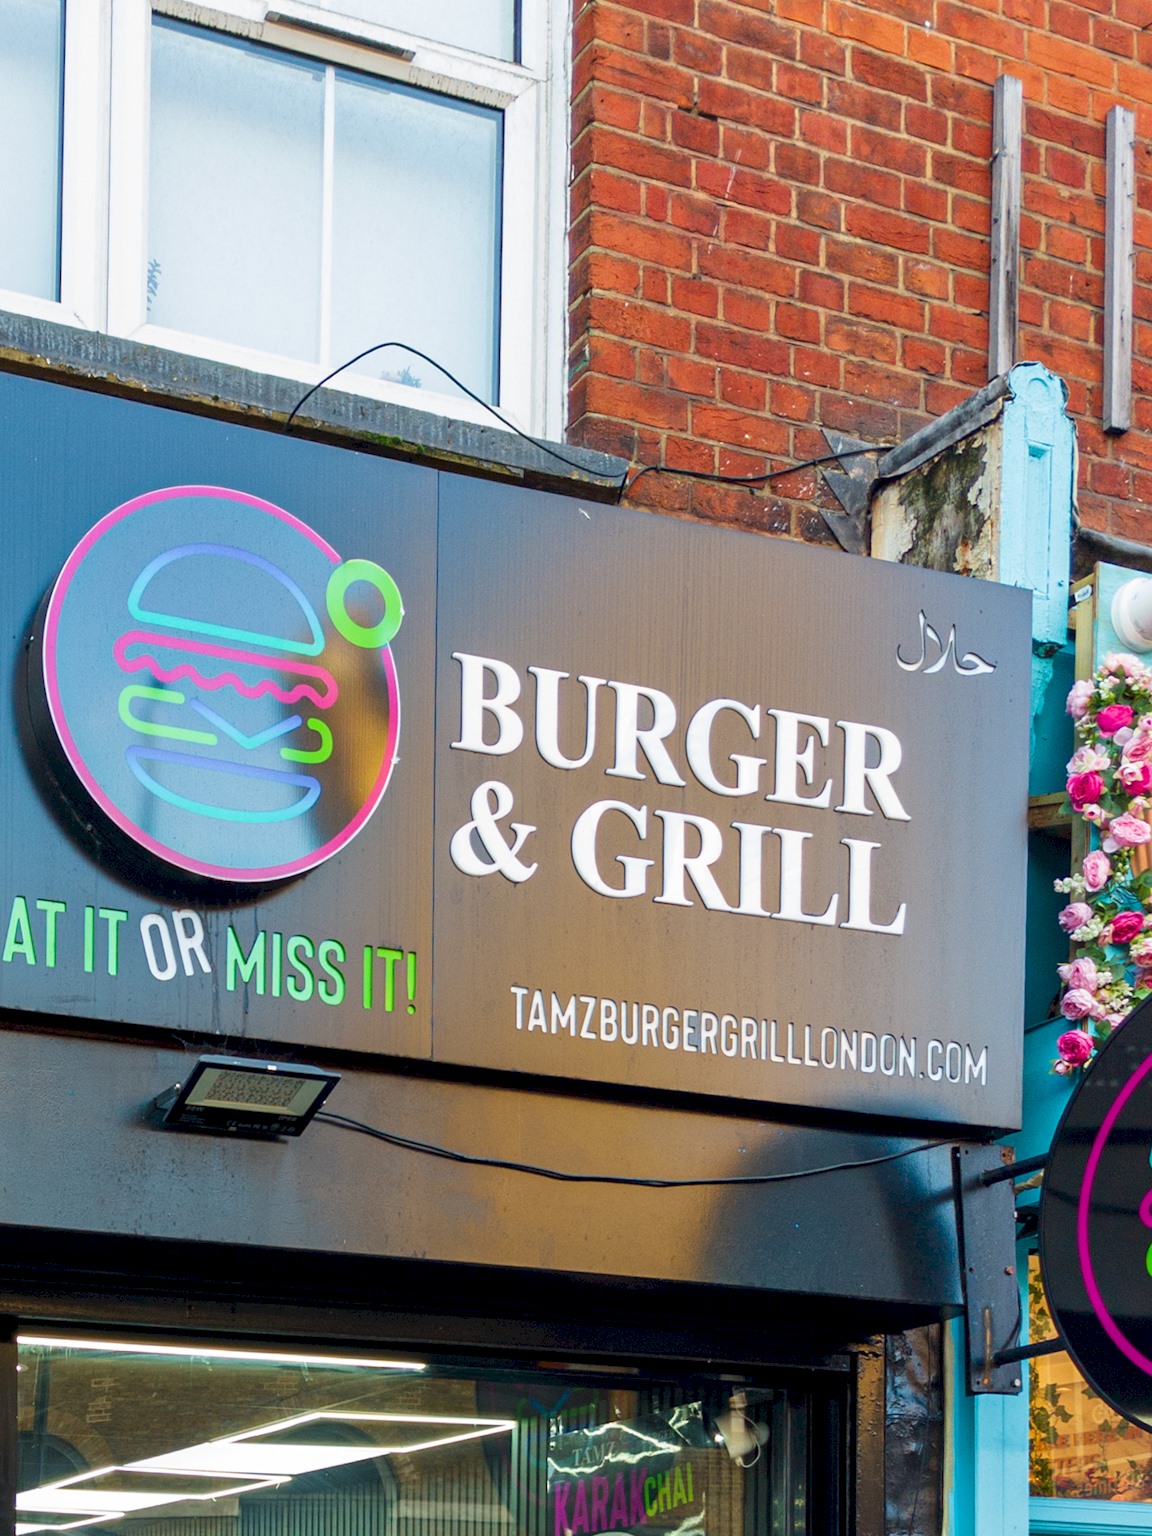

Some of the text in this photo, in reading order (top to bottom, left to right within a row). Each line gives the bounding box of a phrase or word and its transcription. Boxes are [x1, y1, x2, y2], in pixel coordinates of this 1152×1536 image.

[895, 609, 997, 679] حلال
[450, 650, 911, 822] BURGER
[449, 780, 907, 937] & GRILL
[82, 905, 129, 978] IT
[138, 905, 212, 983] OR
[225, 924, 346, 1009] MISS
[361, 946, 418, 1016] IT!
[509, 983, 989, 1089] TAMZBURGERGRILLLONDON.COM
[644, 1461, 694, 1518] CHAI
